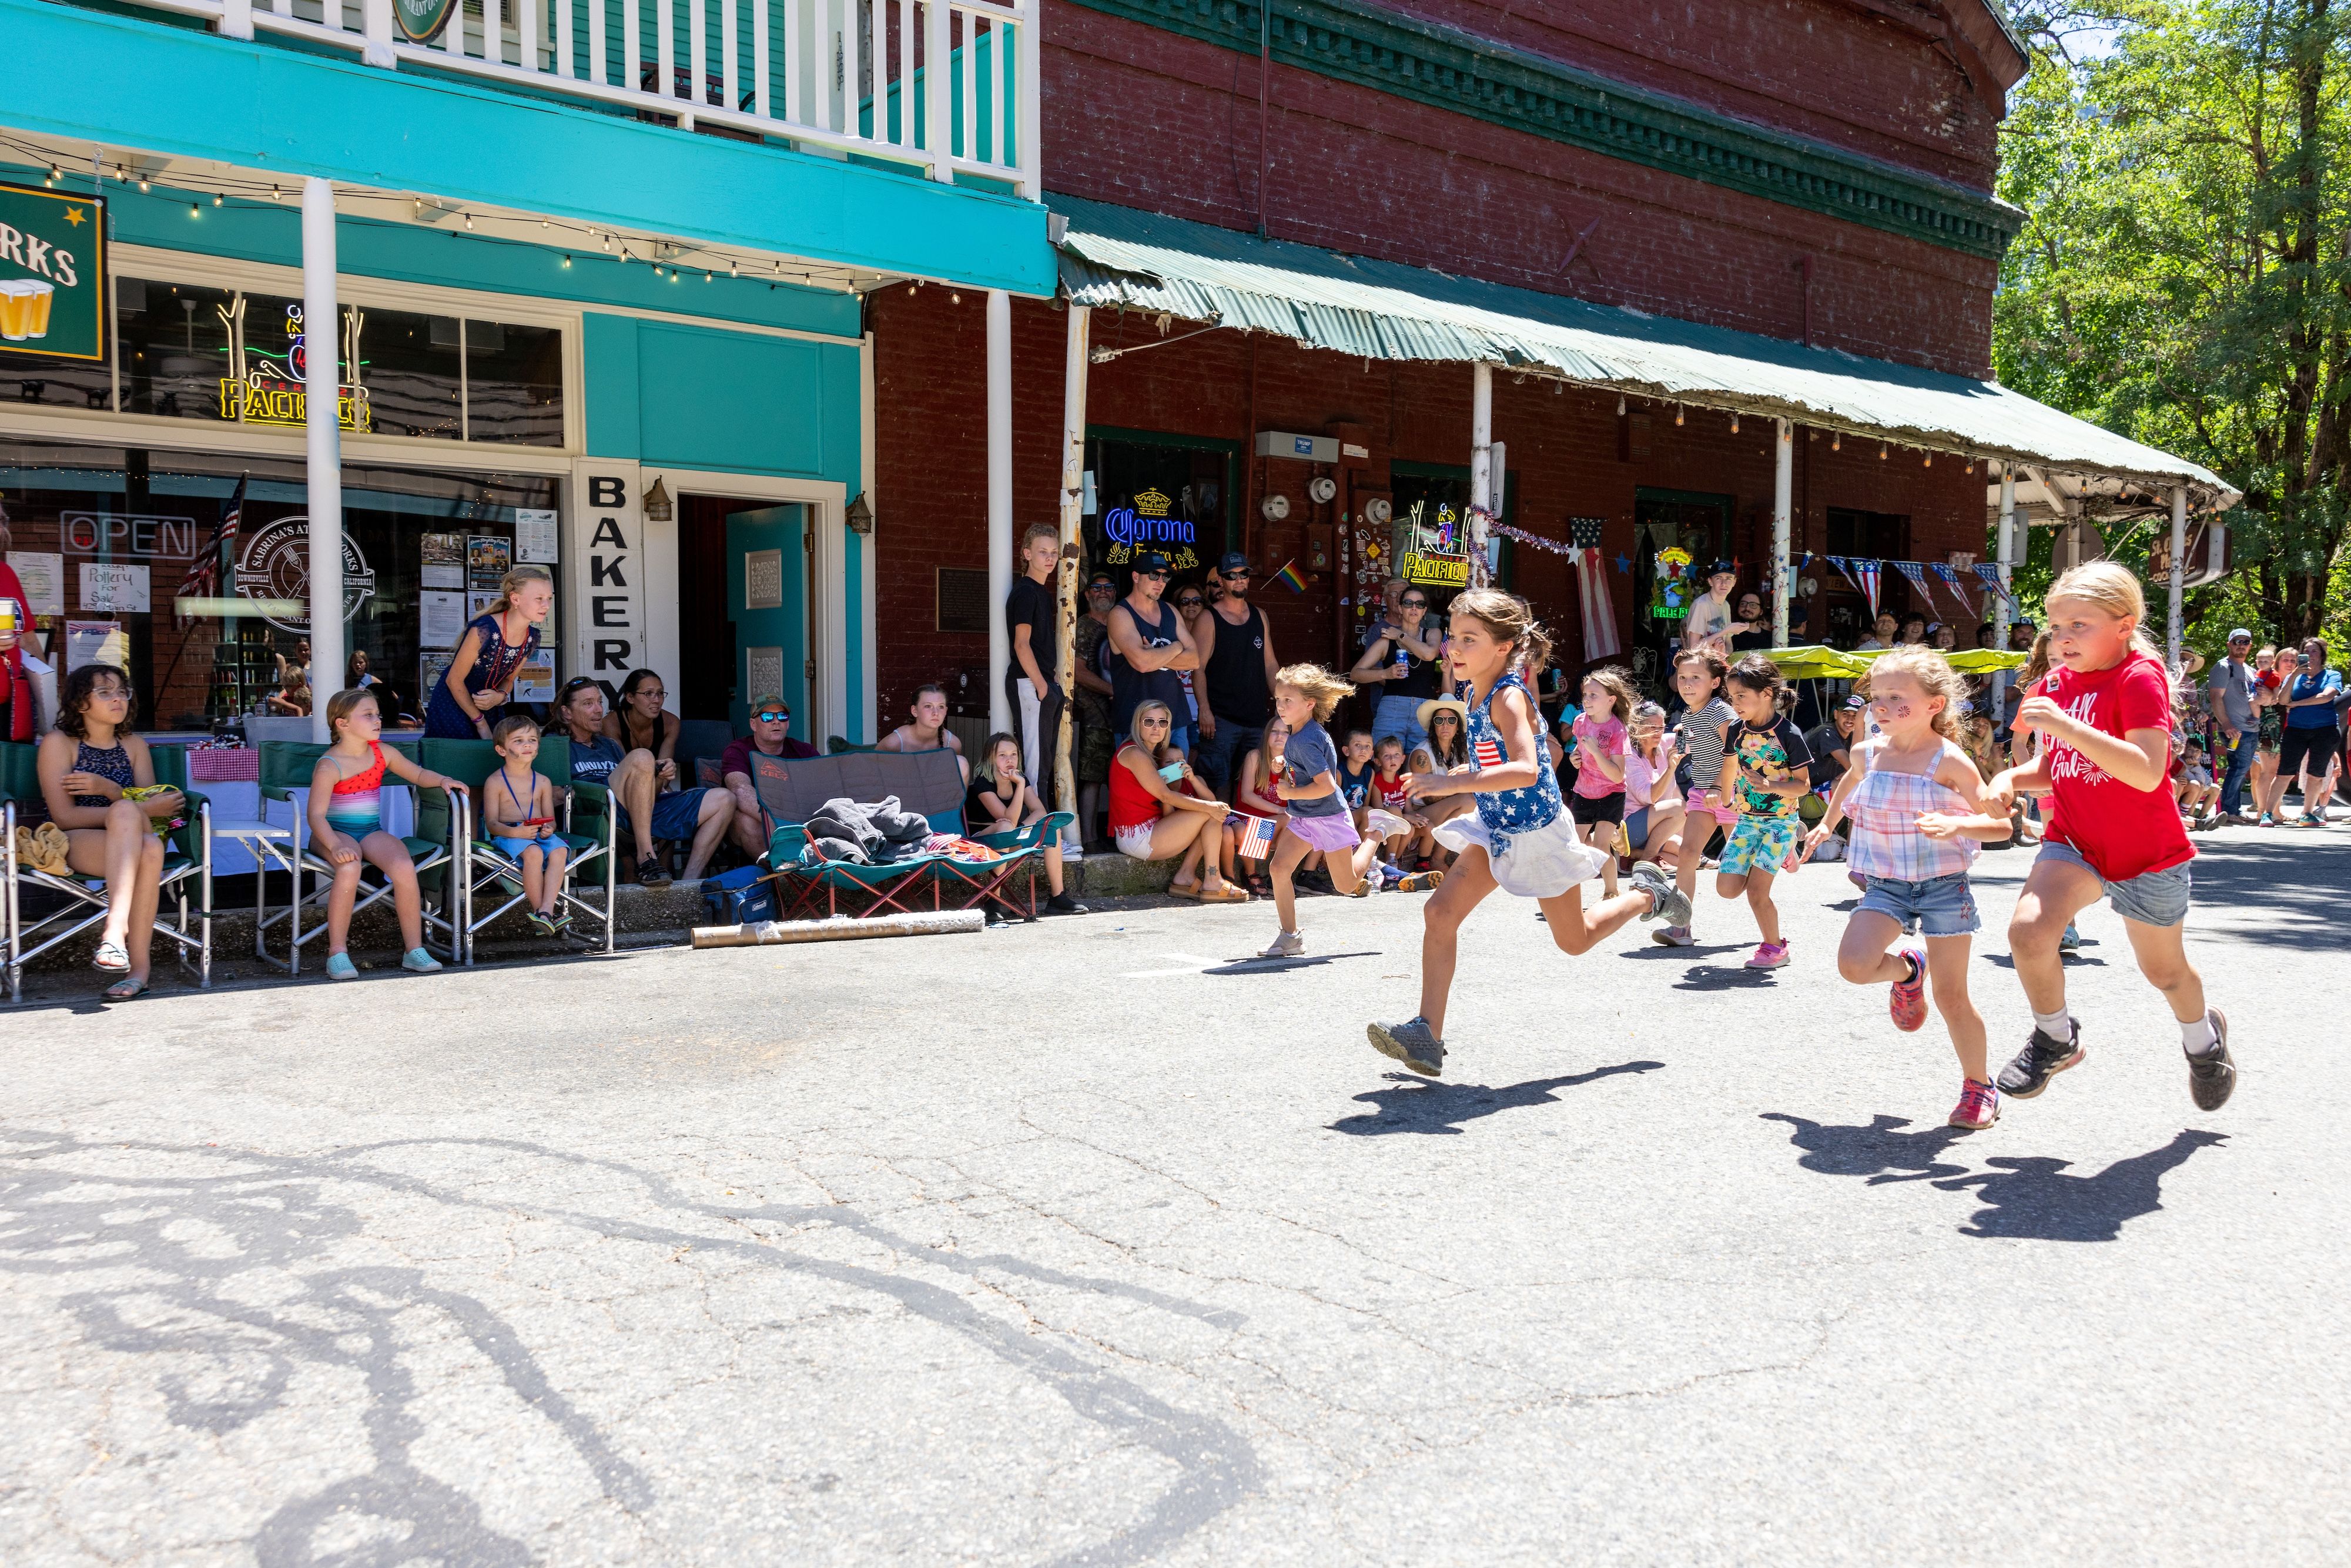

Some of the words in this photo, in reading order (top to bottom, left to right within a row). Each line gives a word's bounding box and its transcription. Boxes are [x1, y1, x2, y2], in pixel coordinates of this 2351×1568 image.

[220, 377, 371, 424] PACICO
[69, 516, 188, 555] OPEN
[1106, 508, 1195, 547] Corona
[252, 525, 294, 568] SABRINA'S
[341, 541, 359, 571] ORKS
[89, 568, 133, 586] Pottery
[343, 577, 372, 587] CALIFORNIA
[1402, 552, 1468, 581] PACIFICO
[91, 591, 120, 604] Sale
[343, 594, 354, 608] VER
[588, 475, 631, 711] BAKERY
[1653, 605, 1677, 619] PALE
[2064, 692, 2098, 725] All
[2051, 750, 2080, 785] Girl
